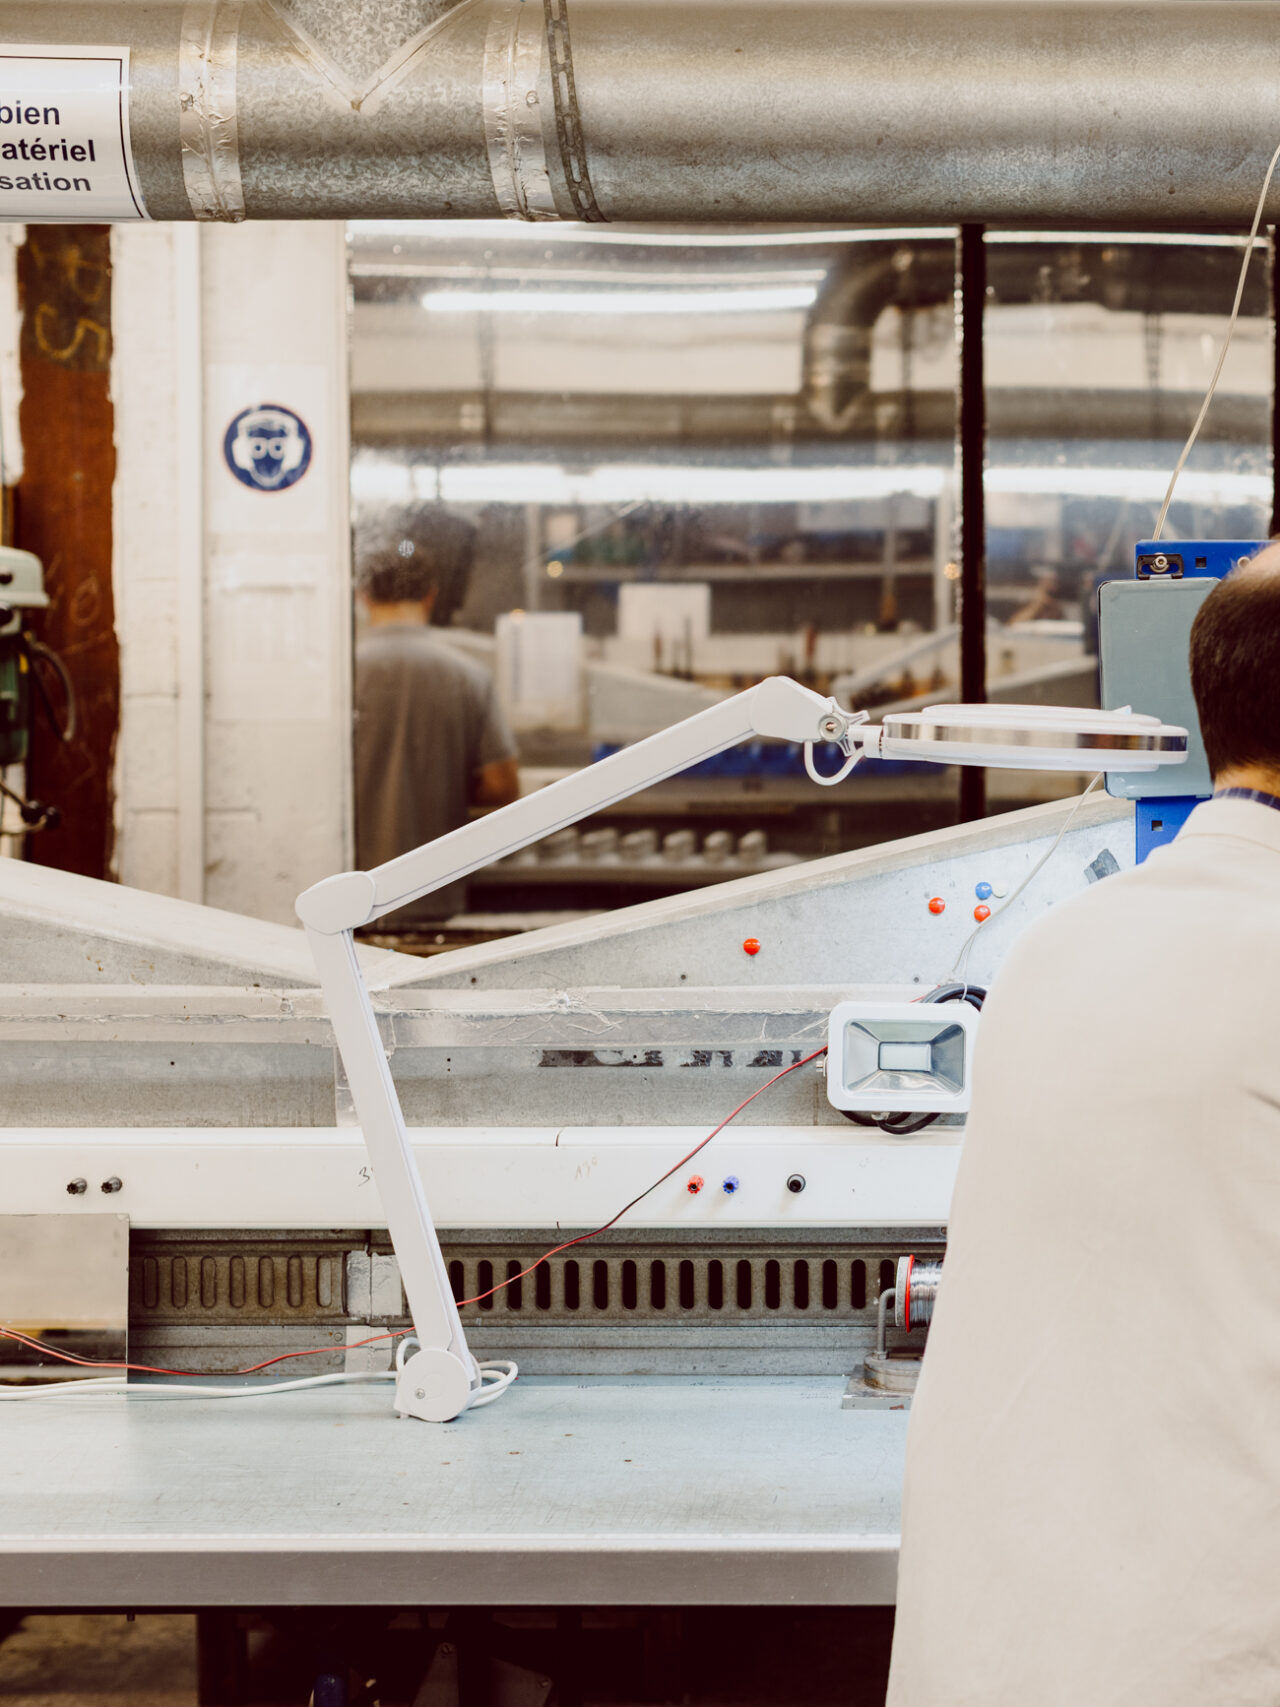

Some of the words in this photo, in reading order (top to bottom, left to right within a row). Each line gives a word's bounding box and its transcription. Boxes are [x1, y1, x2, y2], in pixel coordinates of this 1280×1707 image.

[0, 98, 60, 125] bien
[1, 137, 96, 162] atériel
[0, 172, 92, 191] sation
